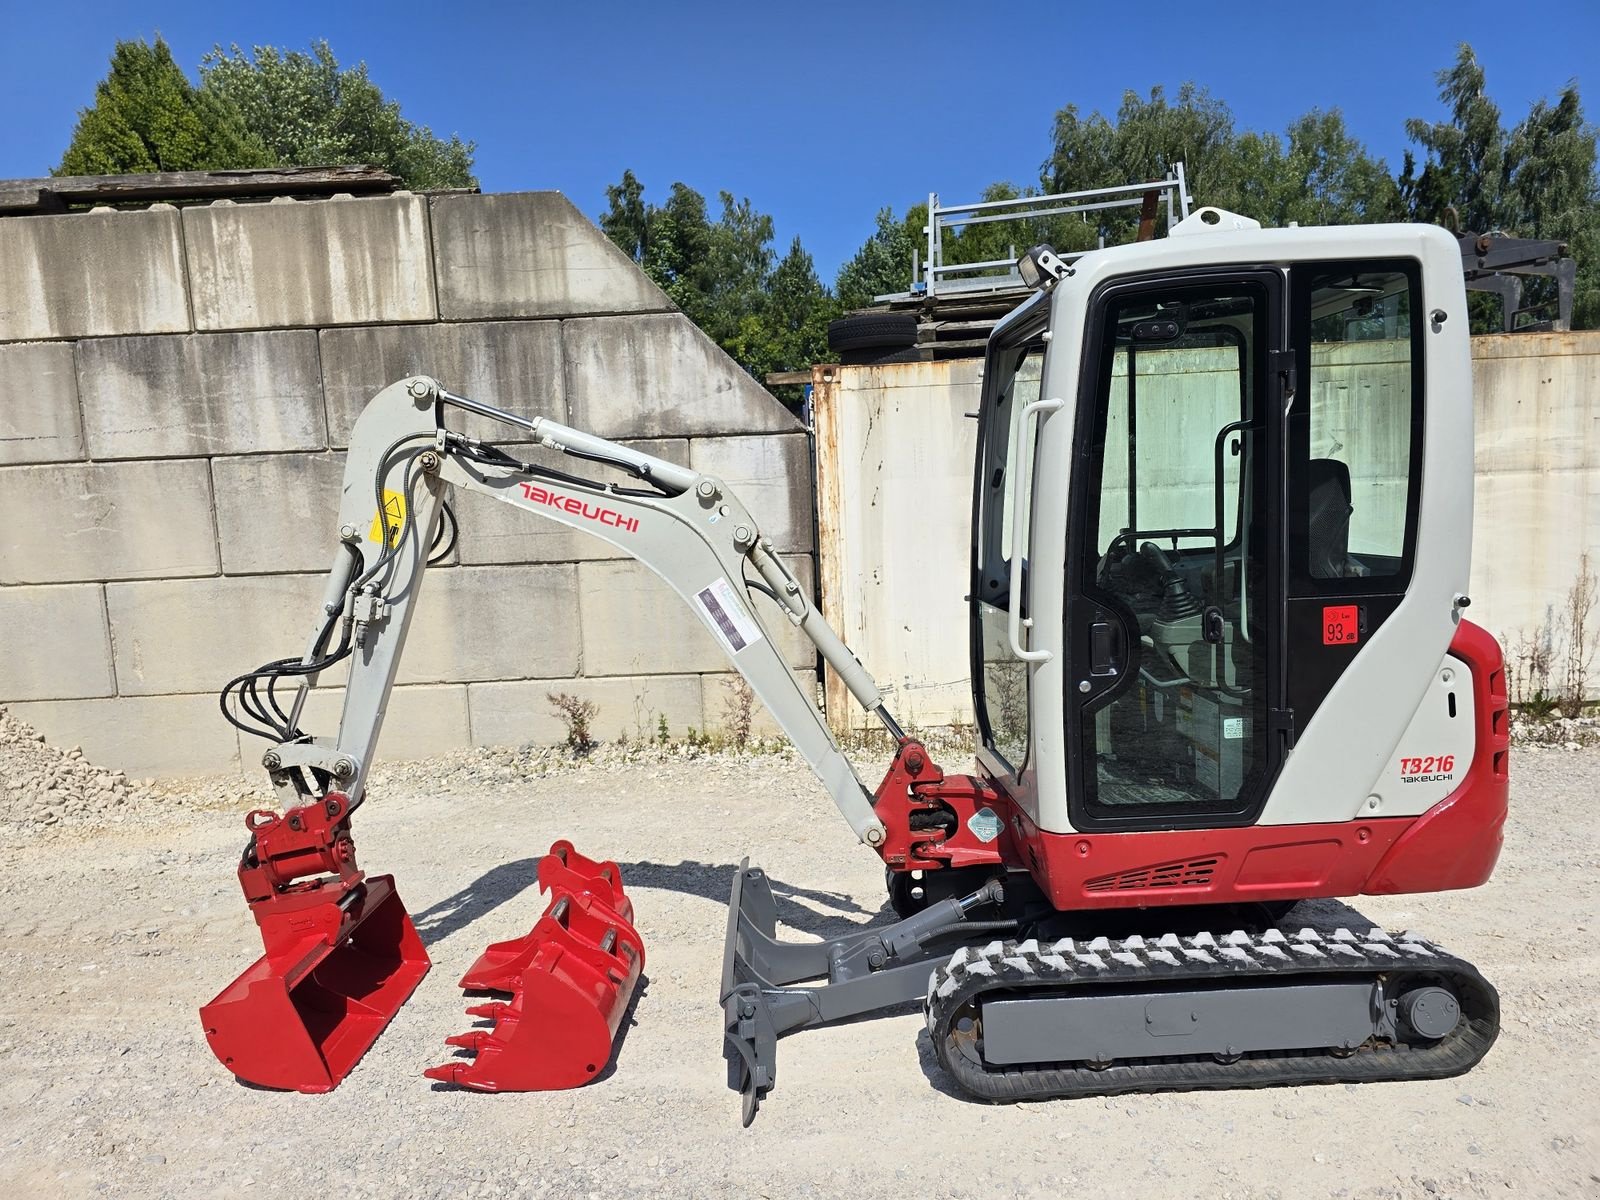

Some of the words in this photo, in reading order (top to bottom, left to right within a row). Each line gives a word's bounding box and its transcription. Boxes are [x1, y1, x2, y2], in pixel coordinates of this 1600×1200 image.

[1327, 623, 1343, 641] 93
[1346, 632, 1355, 641] dB
[1400, 755, 1455, 775] TB216
